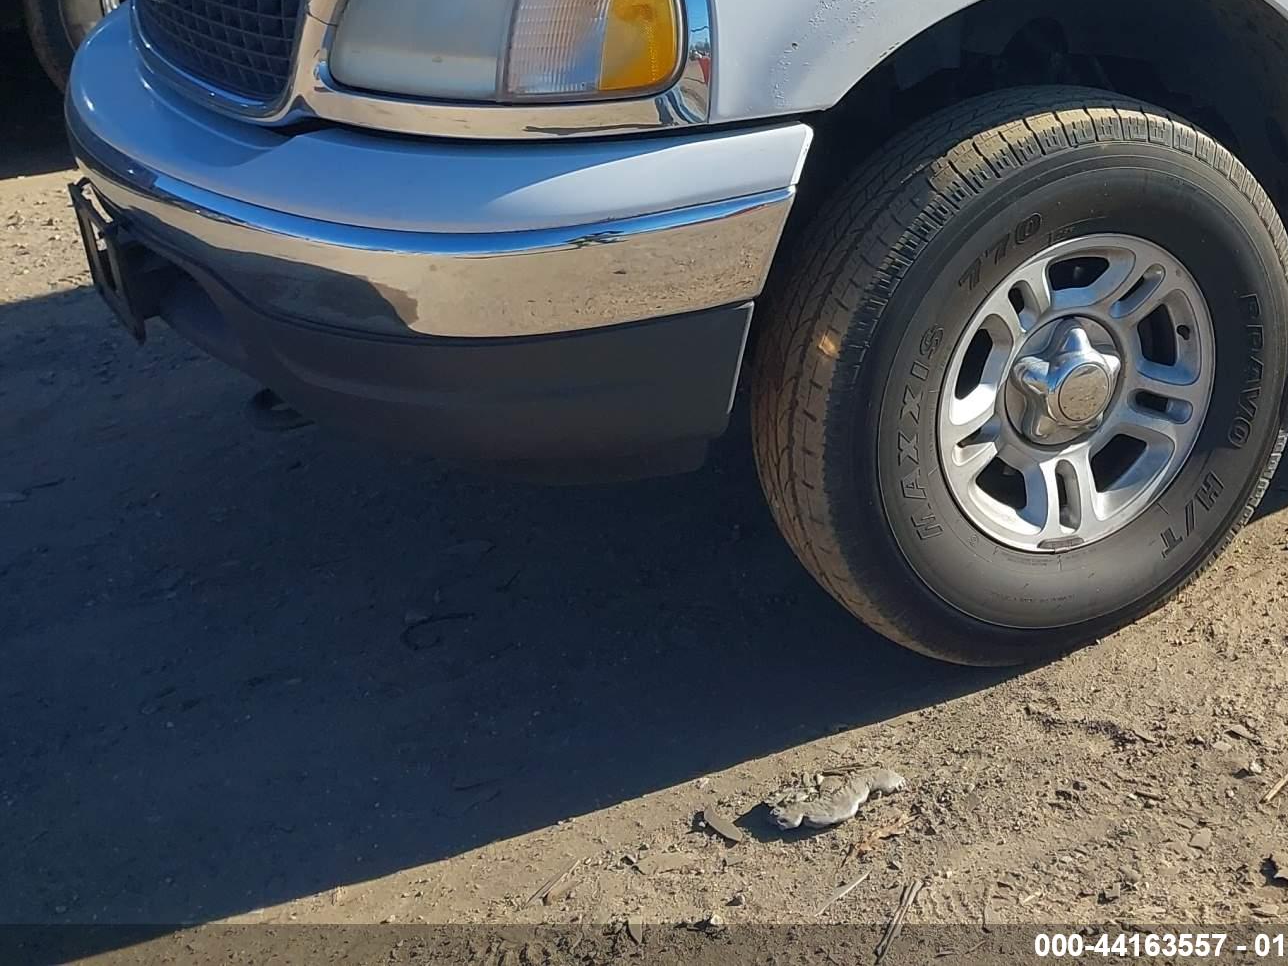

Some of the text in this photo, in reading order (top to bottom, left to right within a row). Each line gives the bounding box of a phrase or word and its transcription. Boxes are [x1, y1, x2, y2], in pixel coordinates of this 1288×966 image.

[957, 212, 1042, 291] 770
[898, 324, 945, 541] MAXXIS
[1160, 470, 1226, 559] H/T
